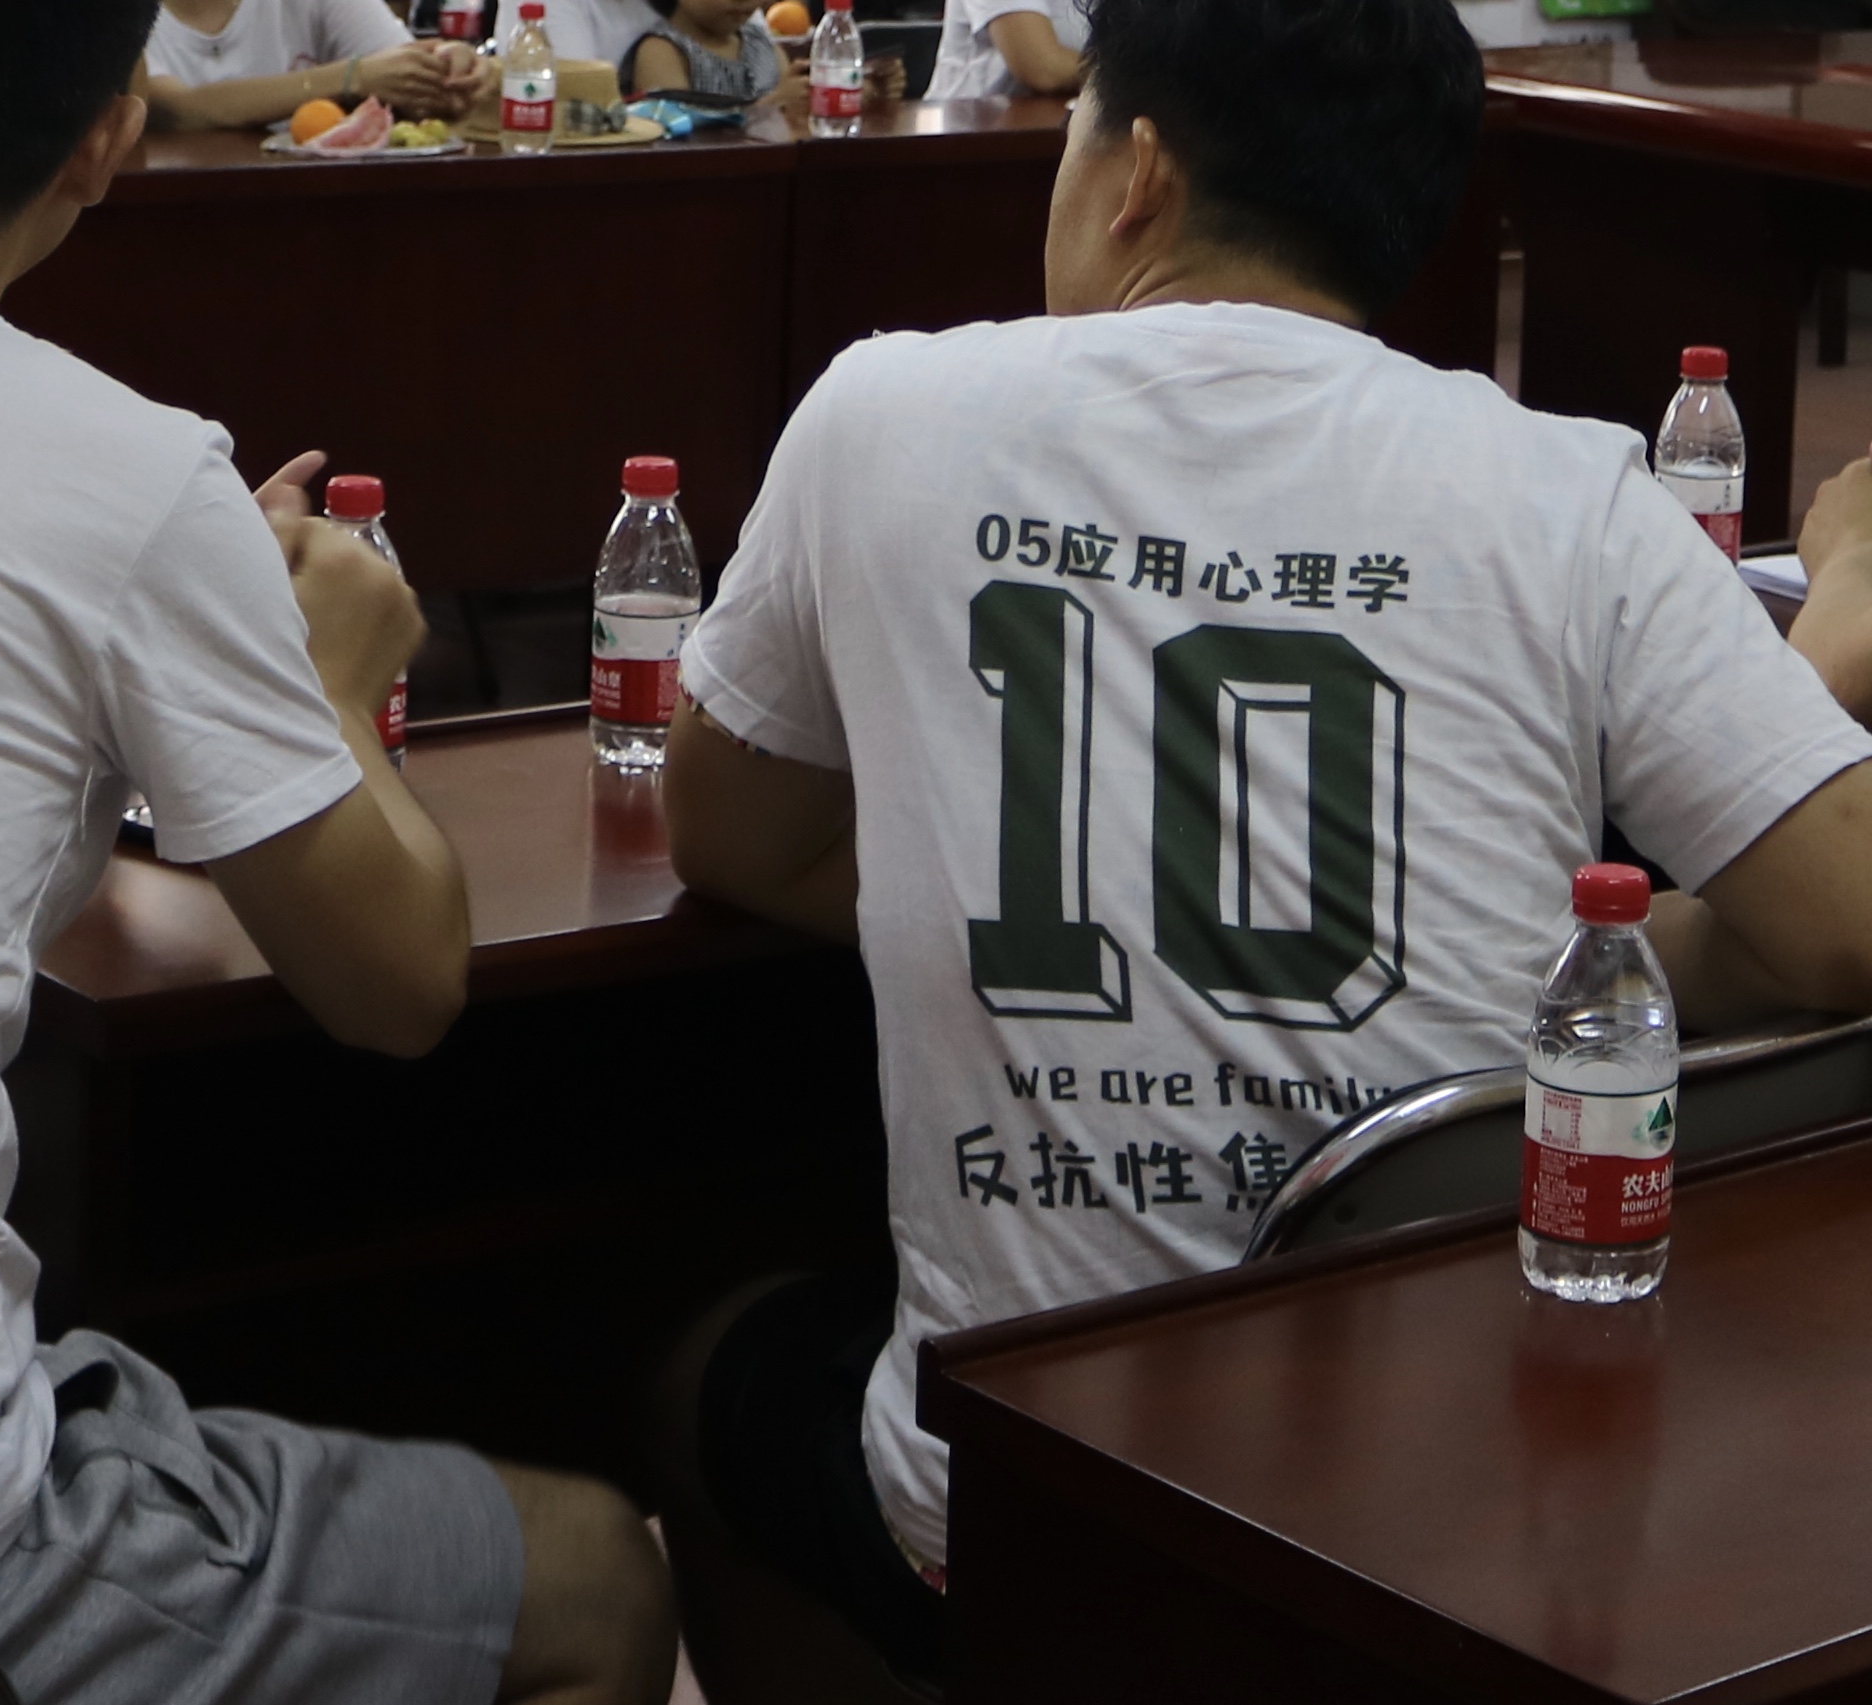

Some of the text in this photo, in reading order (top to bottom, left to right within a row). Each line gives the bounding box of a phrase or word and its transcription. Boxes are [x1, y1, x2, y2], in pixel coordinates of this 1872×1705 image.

[975, 513, 1412, 612] 05应用心理学
[968, 579, 1407, 1032] 10
[1004, 1063, 1078, 1101] we
[1100, 1070, 1194, 1107] are
